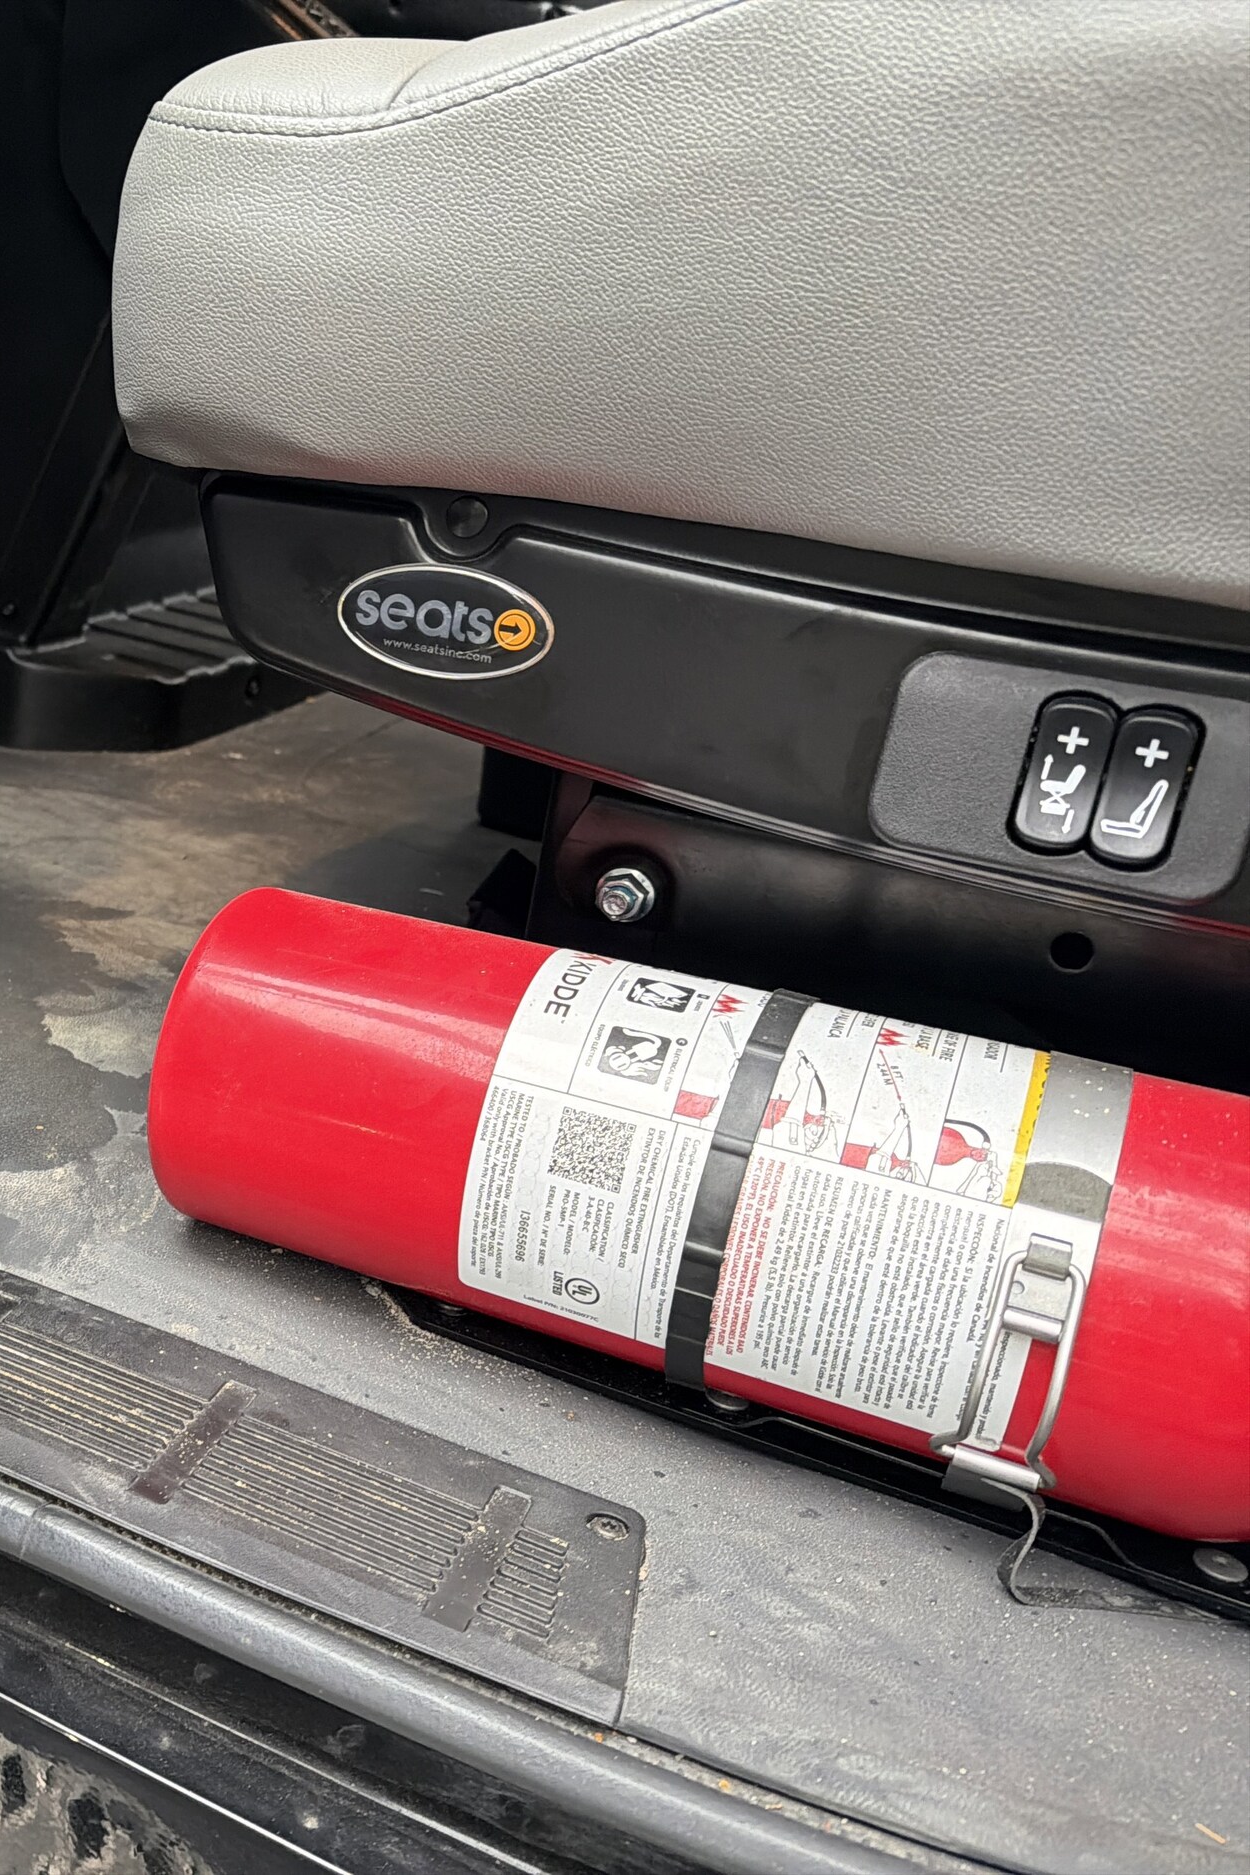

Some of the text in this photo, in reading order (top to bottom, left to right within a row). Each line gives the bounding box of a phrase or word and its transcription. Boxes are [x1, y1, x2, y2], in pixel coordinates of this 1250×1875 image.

[355, 589, 494, 645] seats
[383, 637, 492, 664] www.seatsinc.com
[544, 961, 594, 1017] KIDDE
[914, 1033, 931, 1051] BASE
[937, 1044, 955, 1063] FIRE
[498, 1087, 508, 1105] Valid
[883, 1076, 893, 1086] M
[479, 1085, 499, 1141] 466400 368064
[492, 1105, 503, 1121] only
[506, 1090, 517, 1109] USCG
[521, 1095, 534, 1121] TESTED
[489, 1122, 498, 1138] with
[496, 1110, 511, 1143] Approval
[517, 1122, 526, 1133] TO
[483, 1139, 494, 1165] bracket
[494, 1143, 502, 1156] No.
[508, 1137, 522, 1174] PROBADO
[677, 1136, 691, 1163] Estados
[686, 1138, 701, 1167] Cumple
[484, 1161, 498, 1201] Aprobación
[487, 1092, 525, 1257] MARINE TYPE USCG TYPE TIPO MARINO TIPO USCG
[503, 1175, 514, 1200] SEGÚN
[671, 1164, 683, 1190] Unidos
[680, 1182, 689, 1193] los
[683, 1167, 692, 1181] con
[786, 1165, 802, 1202] comercial
[799, 1167, 813, 1189] fugas
[475, 1182, 485, 1209] Número
[484, 1201, 491, 1210] de
[545, 1184, 556, 1208] SERIAL
[617, 1127, 655, 1268] EXTINTOR DE INCENDIOS QUÍMICO SECO
[629, 1129, 666, 1254] DRY CHEMICAL FIRE EXTINGUISHER
[805, 1170, 823, 1212] autorizada
[827, 1176, 843, 1215] RESUMEN
[854, 1182, 869, 1214] personas
[474, 1210, 481, 1218] de
[543, 1210, 551, 1223] NO.
[562, 1191, 580, 1255] MODEL MODELO:
[580, 1195, 596, 1232] 3-A:40-B:C
[587, 1198, 607, 1252] CLASIFICACIÓN:
[672, 1193, 686, 1228] requisitos
[740, 1212, 750, 1230] USO
[748, 1207, 762, 1242] EXPONER
[780, 1203, 792, 1226] Kidde
[914, 1199, 931, 1238] extracción
[925, 1201, 941, 1240] encuentra
[471, 1218, 479, 1235] pieza
[596, 1201, 615, 1257] CLASSIFICATION
[655, 1215, 671, 1256] Ensamblado
[670, 1228, 678, 1240] del
[802, 1210, 824, 1271] Lleve extintor
[830, 1180, 860, 1274] número parte 21032233
[847, 1215, 863, 1252] calificadas
[898, 1220, 914, 1253] boquilla
[947, 1207, 964, 1245] existencia
[960, 1210, 975, 1243] mensual
[989, 1218, 1006, 1252] Nacional
[539, 1238, 547, 1247] DE
[729, 1230, 746, 1280] INADECUADO
[754, 1240, 765, 1259] DEBE
[875, 1193, 908, 1304] asegurarse dentro
[654, 1257, 661, 1266] en
[660, 1240, 676, 1288] Departamento
[780, 1244, 793, 1272] Rellene
[852, 1247, 865, 1275] observe
[916, 1204, 953, 1324] completamente cargada cuando
[938, 1257, 951, 1281] daños
[550, 1270, 563, 1295] LISTED
[649, 1266, 661, 1290] México.
[659, 1288, 667, 1297] de
[803, 1270, 820, 1304] Recargue
[835, 1272, 848, 1297] utilicen
[977, 1264, 993, 1301] Incendios
[523, 1294, 543, 1305] Label
[779, 1283, 795, 1314] descarga
[851, 1270, 871, 1322] mantenimiento
[932, 1282, 945, 1305] físicos
[940, 1283, 957, 1321] frecuencia
[952, 1283, 969, 1320] ubicación
[901, 1304, 916, 1335] También
